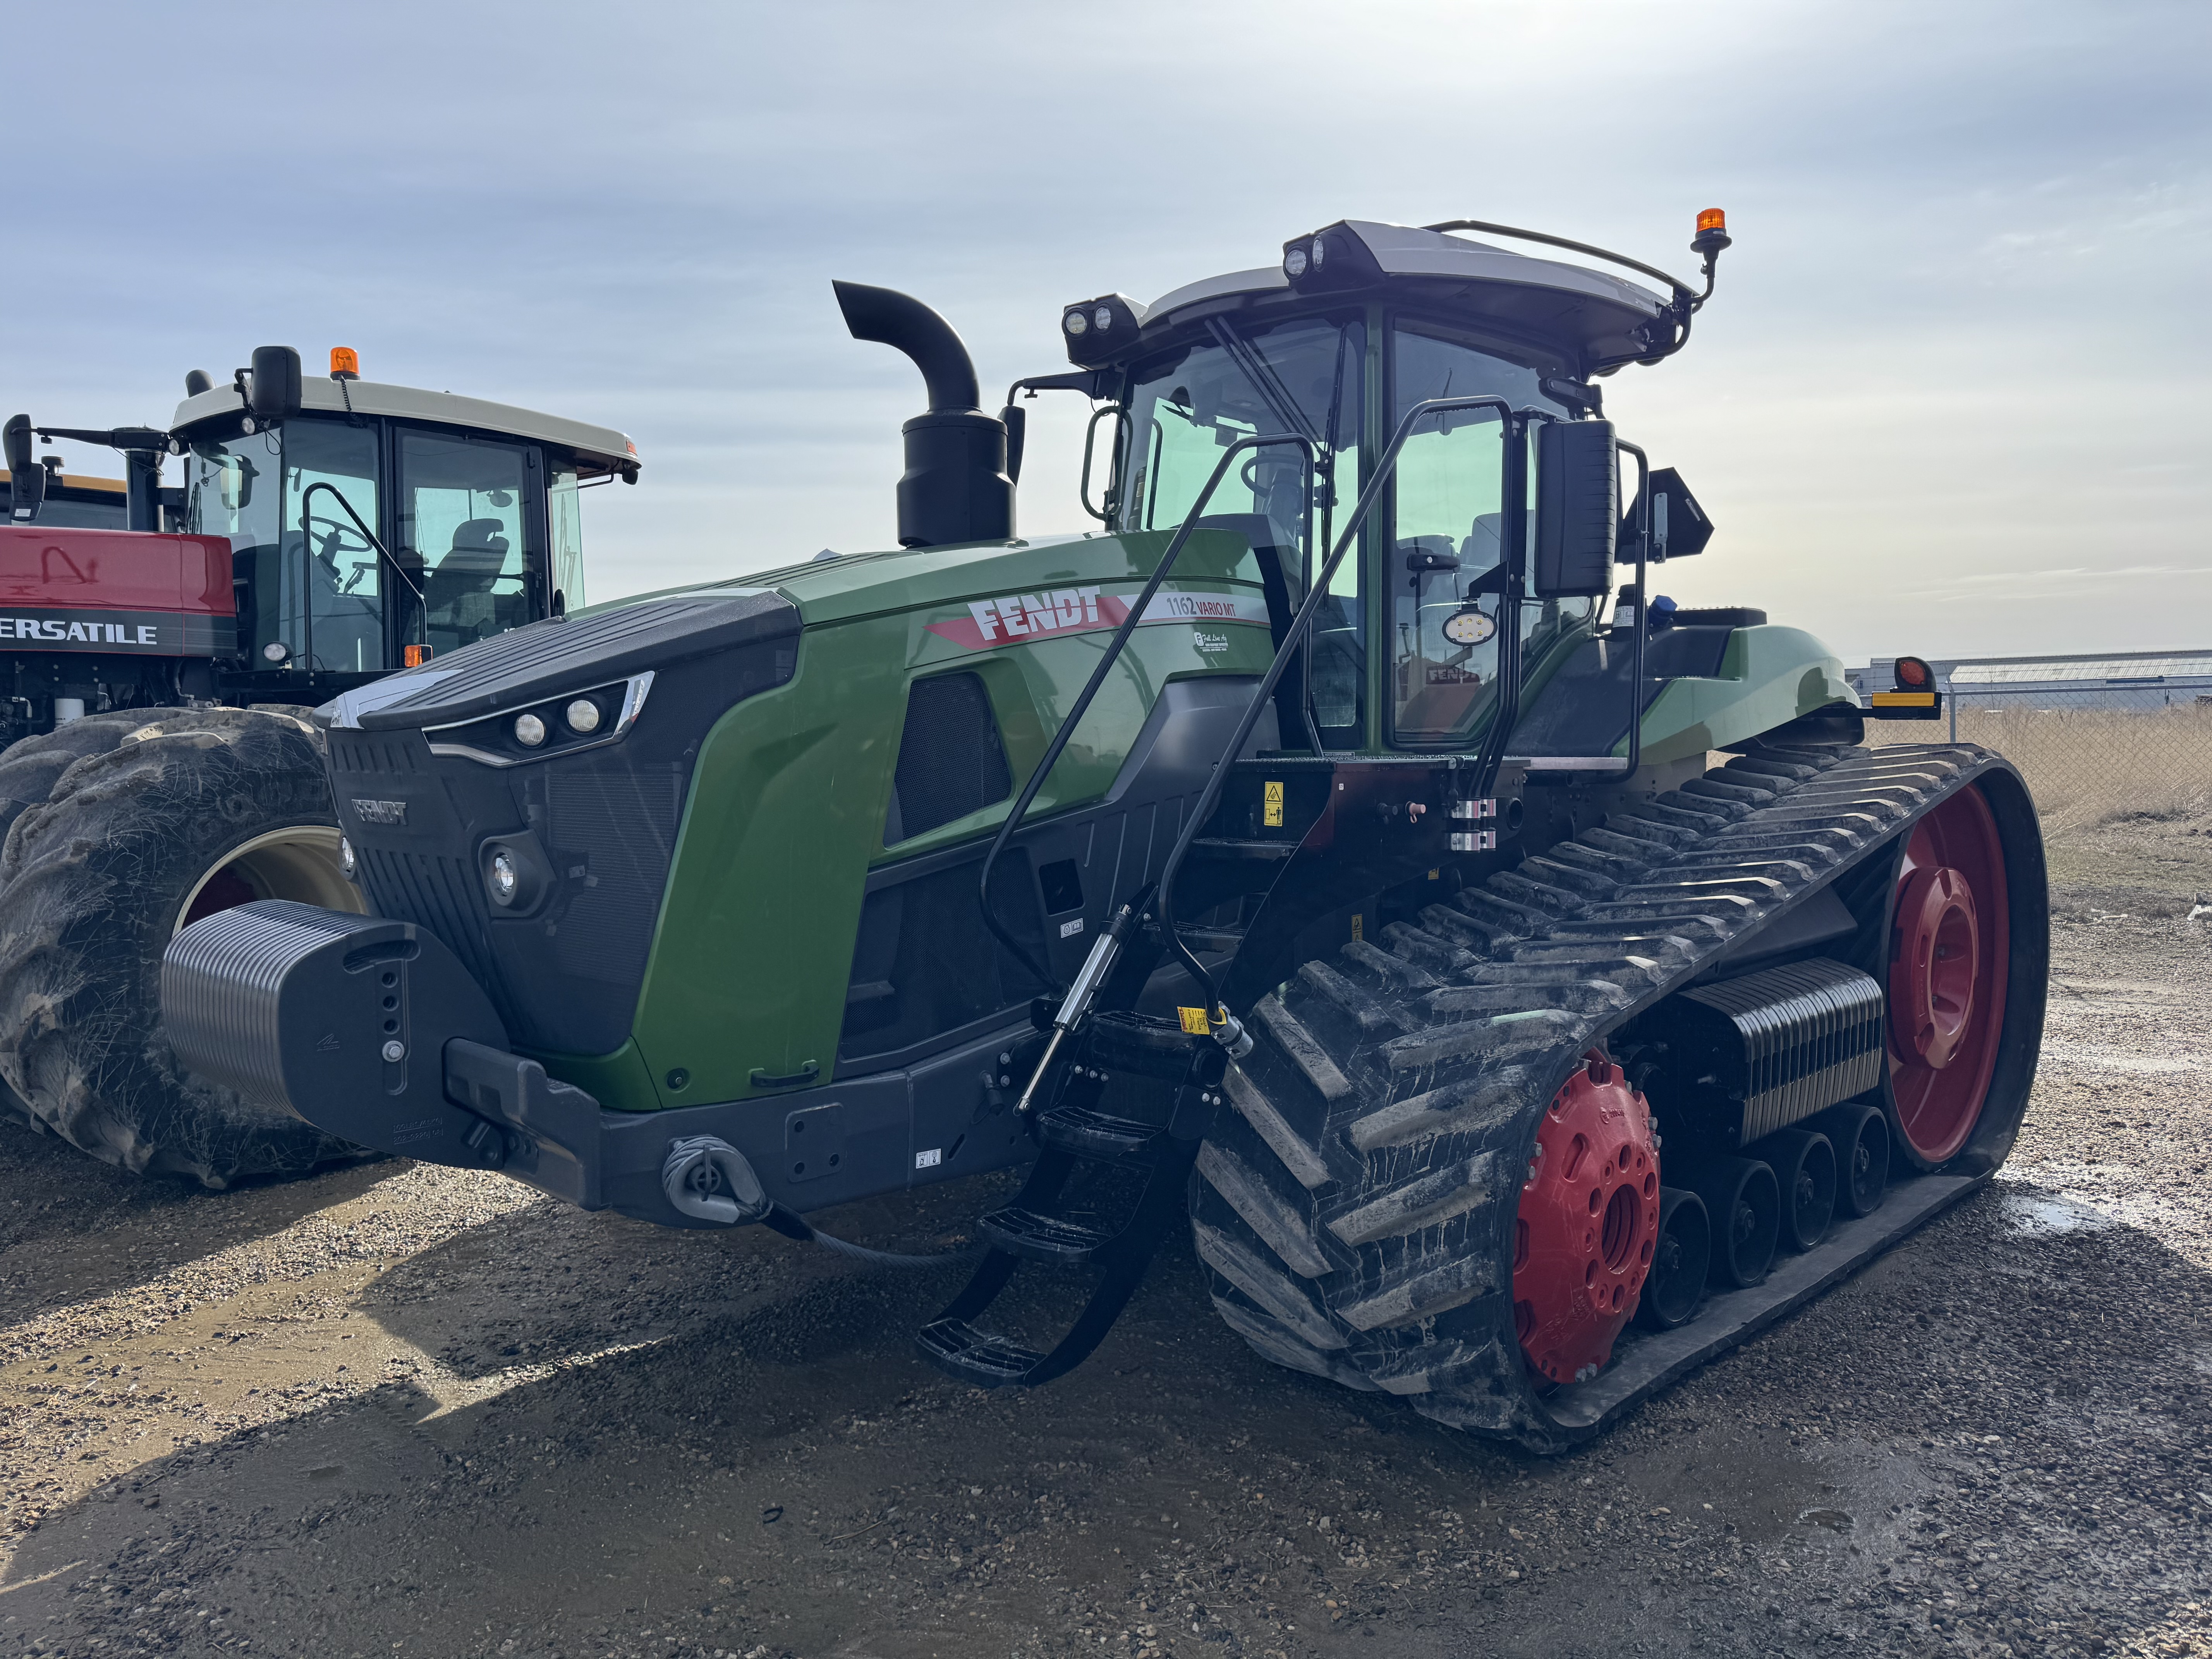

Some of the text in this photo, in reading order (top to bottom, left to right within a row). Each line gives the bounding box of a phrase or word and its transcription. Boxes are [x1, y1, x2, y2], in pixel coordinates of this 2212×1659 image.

[967, 586, 1100, 641] FENDT
[1166, 597, 1236, 617] 1162 VARIO MT
[351, 799, 407, 825] FENDT
